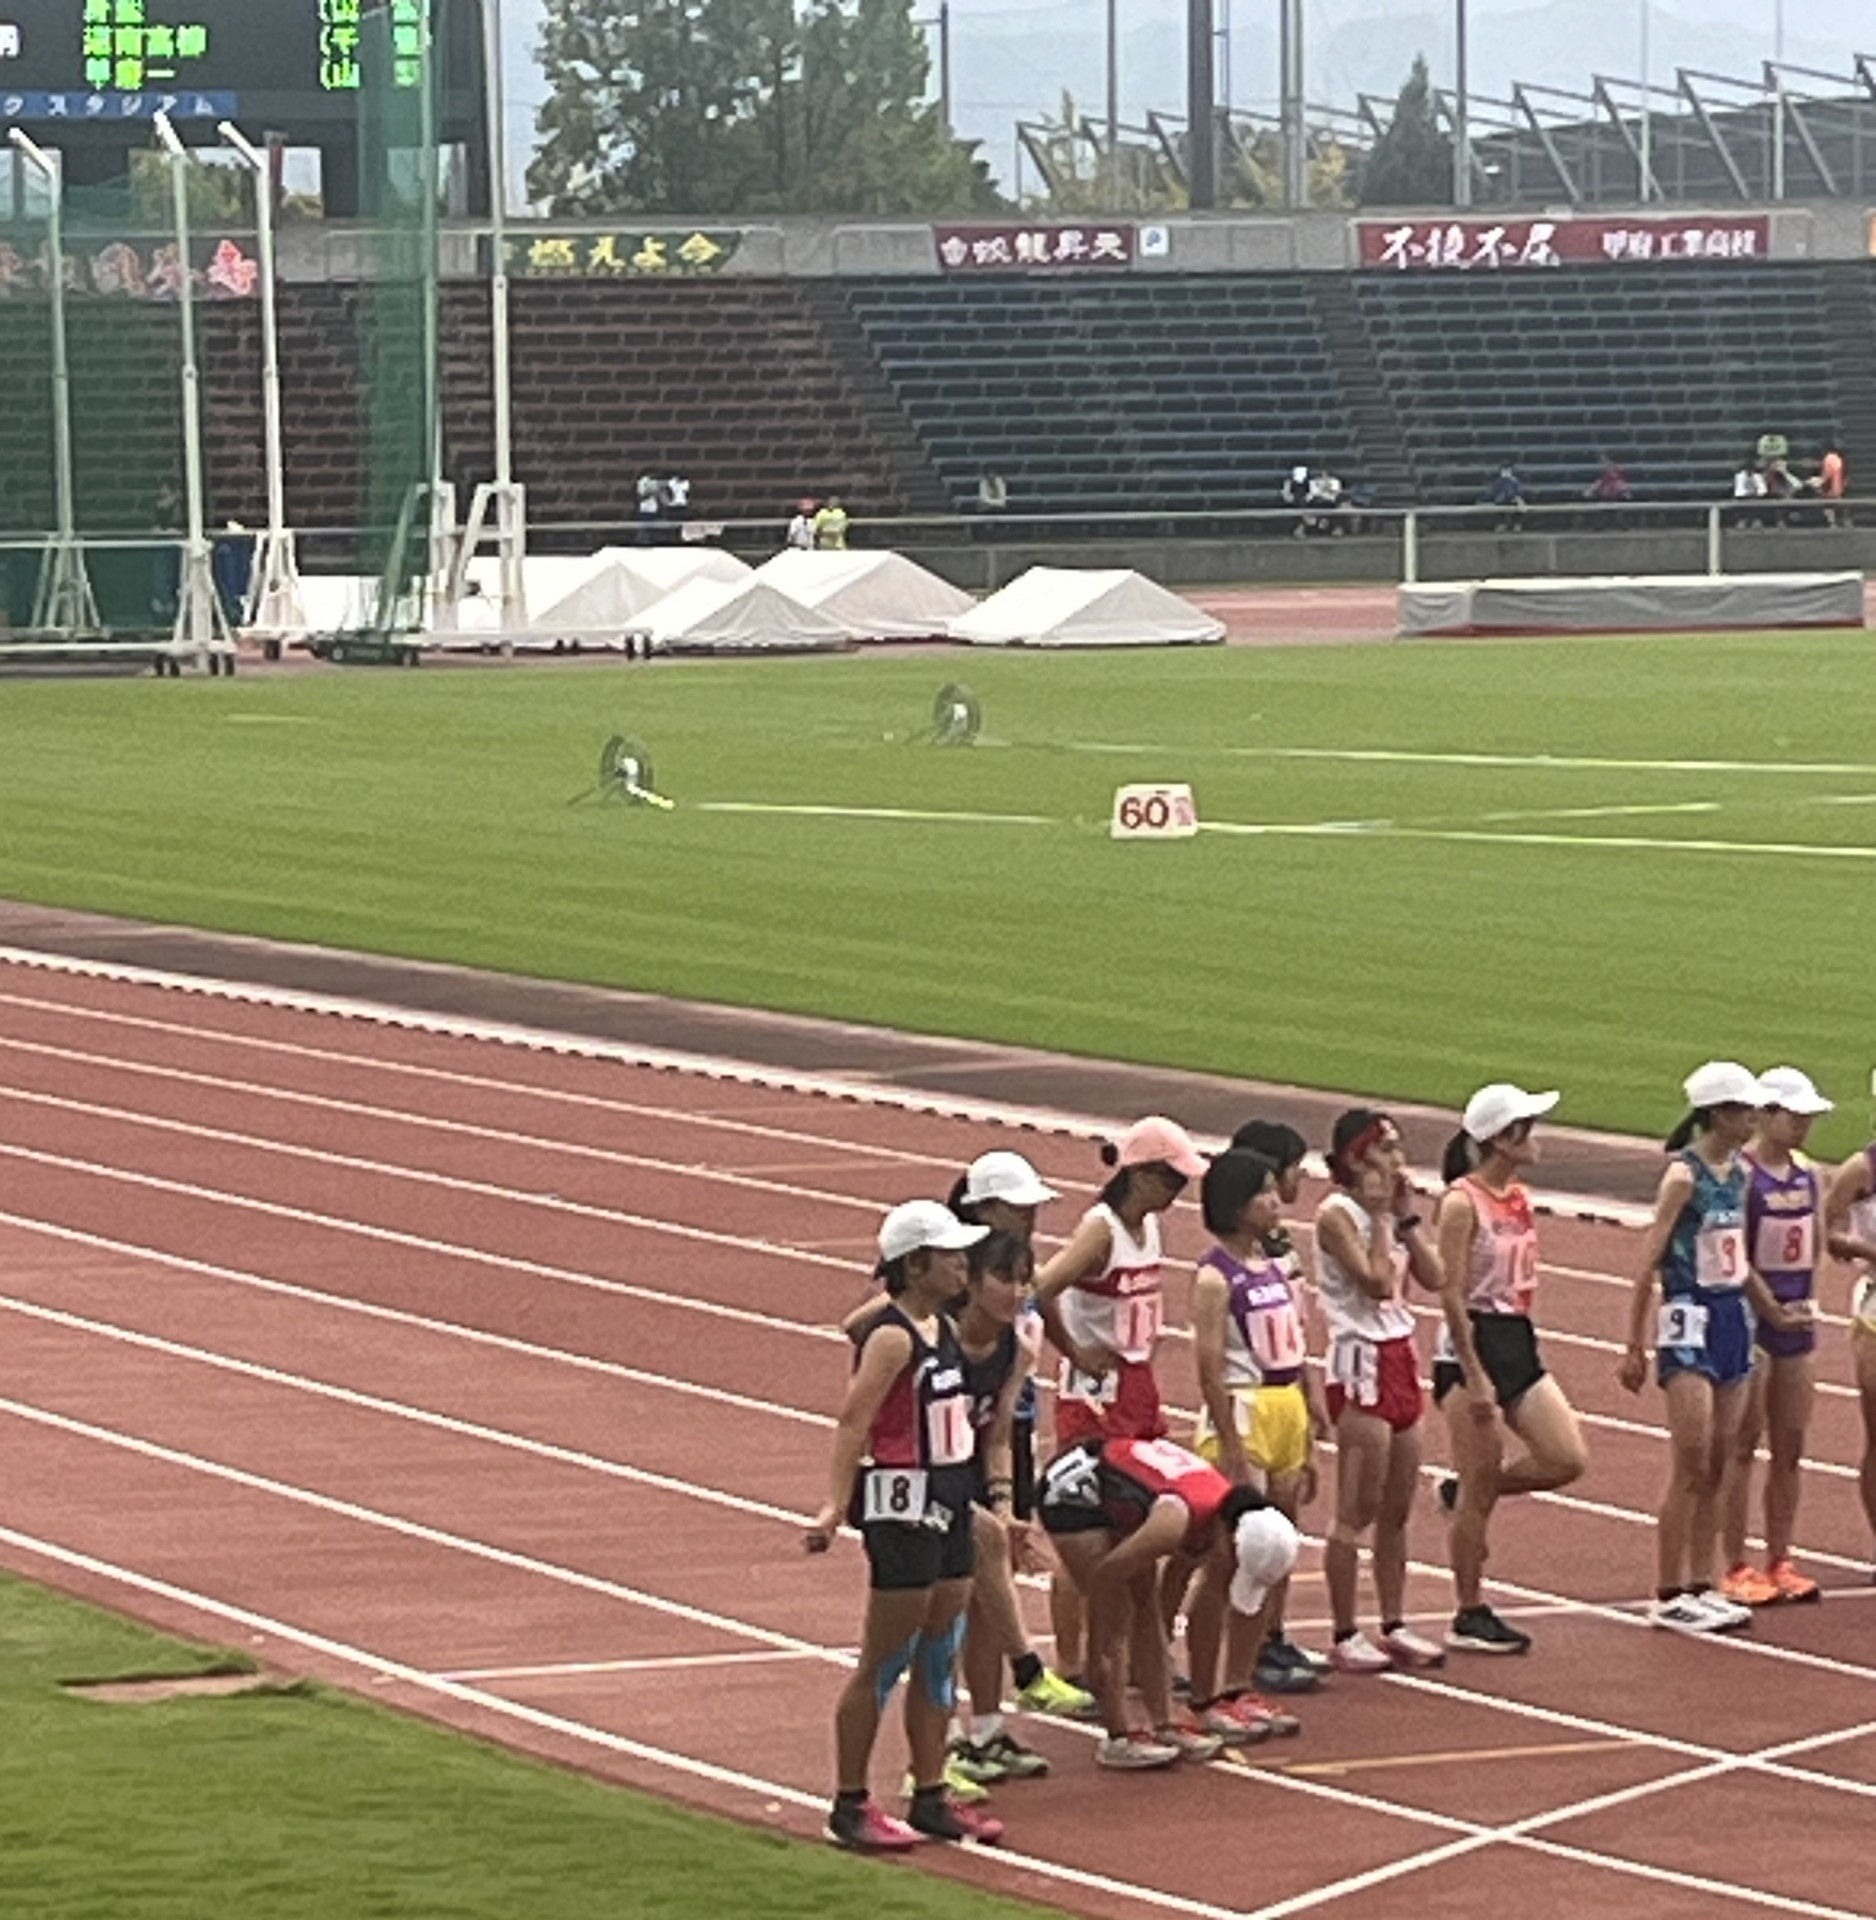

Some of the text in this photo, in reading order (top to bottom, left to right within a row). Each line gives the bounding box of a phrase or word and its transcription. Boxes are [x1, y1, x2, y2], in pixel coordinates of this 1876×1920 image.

[1783, 1225, 1803, 1263] 8
[1669, 1308, 1686, 1340] 9
[872, 1475, 911, 1513] 18
